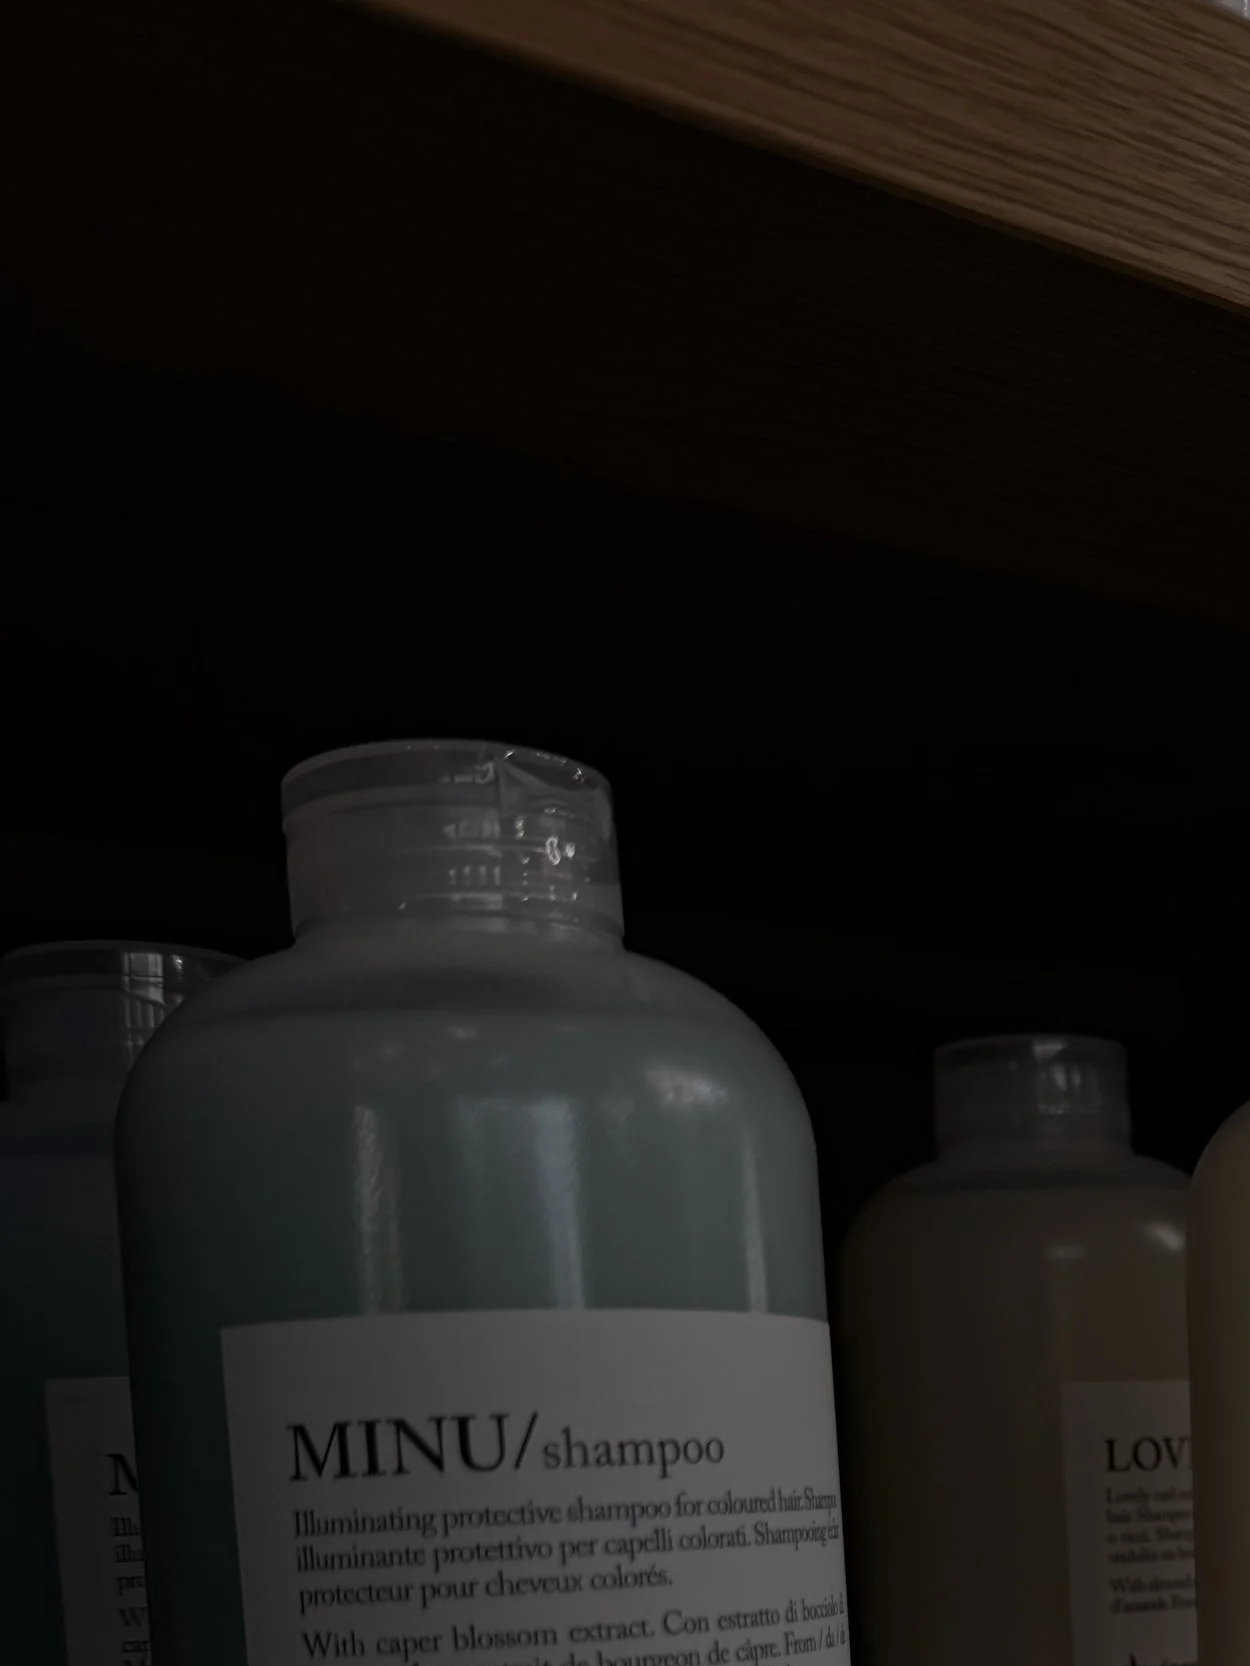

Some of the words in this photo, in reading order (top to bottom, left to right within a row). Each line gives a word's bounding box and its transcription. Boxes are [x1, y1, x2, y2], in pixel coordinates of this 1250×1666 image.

[293, 1506, 437, 1540] Illuminating
[442, 1499, 562, 1537] protective
[568, 1496, 671, 1528] shampoo
[675, 1491, 703, 1517] for
[707, 1483, 776, 1515] coloured
[296, 1545, 426, 1573] illuminante
[433, 1536, 552, 1574] protettivo
[560, 1537, 598, 1566] per
[604, 1527, 674, 1563] capelli
[679, 1524, 751, 1550] colorati.
[299, 1583, 414, 1616] protecteur
[421, 1576, 478, 1611] pour
[485, 1569, 583, 1598] cheveux
[591, 1563, 673, 1591] colorés.
[303, 1629, 366, 1659] With
[376, 1633, 442, 1663] caper
[452, 1622, 558, 1652] blossom
[569, 1618, 655, 1644] extract.
[663, 1609, 710, 1636] Con
[718, 1603, 780, 1631] estratto
[785, 1599, 798, 1625] di
[707, 1641, 732, 1666] de
[783, 1630, 818, 1657] From
